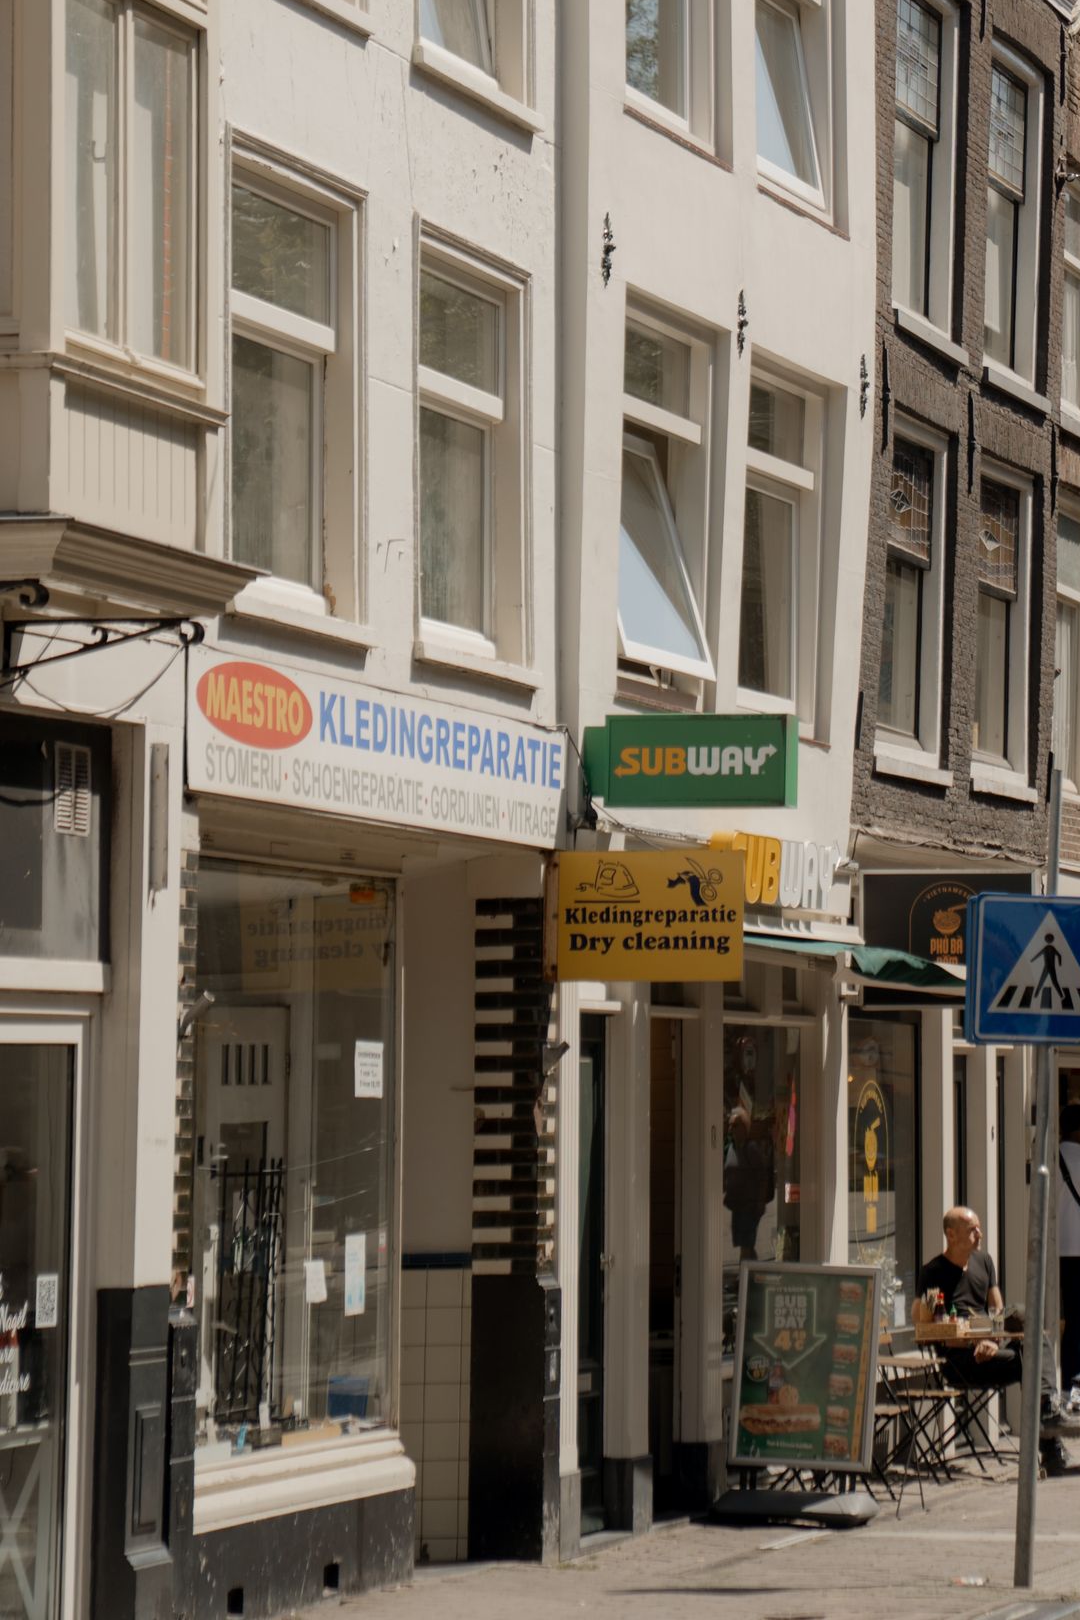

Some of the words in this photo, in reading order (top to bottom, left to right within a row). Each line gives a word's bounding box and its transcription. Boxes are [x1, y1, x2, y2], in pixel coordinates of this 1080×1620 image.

[205, 672, 304, 736] MAESTRO
[319, 690, 562, 789] KLEDINGREPARATIE
[614, 743, 778, 778] SUBWAY
[205, 742, 282, 793] STOMERIJ
[292, 758, 424, 816] SCHOENREPARATIE
[430, 785, 500, 829] GORDIJNEN
[507, 799, 556, 839] VITRAGE
[565, 905, 737, 928] Kledingreparatie
[569, 933, 615, 954] Dry
[623, 931, 731, 955] cleaning
[774, 1295, 807, 1309] SUB
[774, 1316, 807, 1329] DAY
